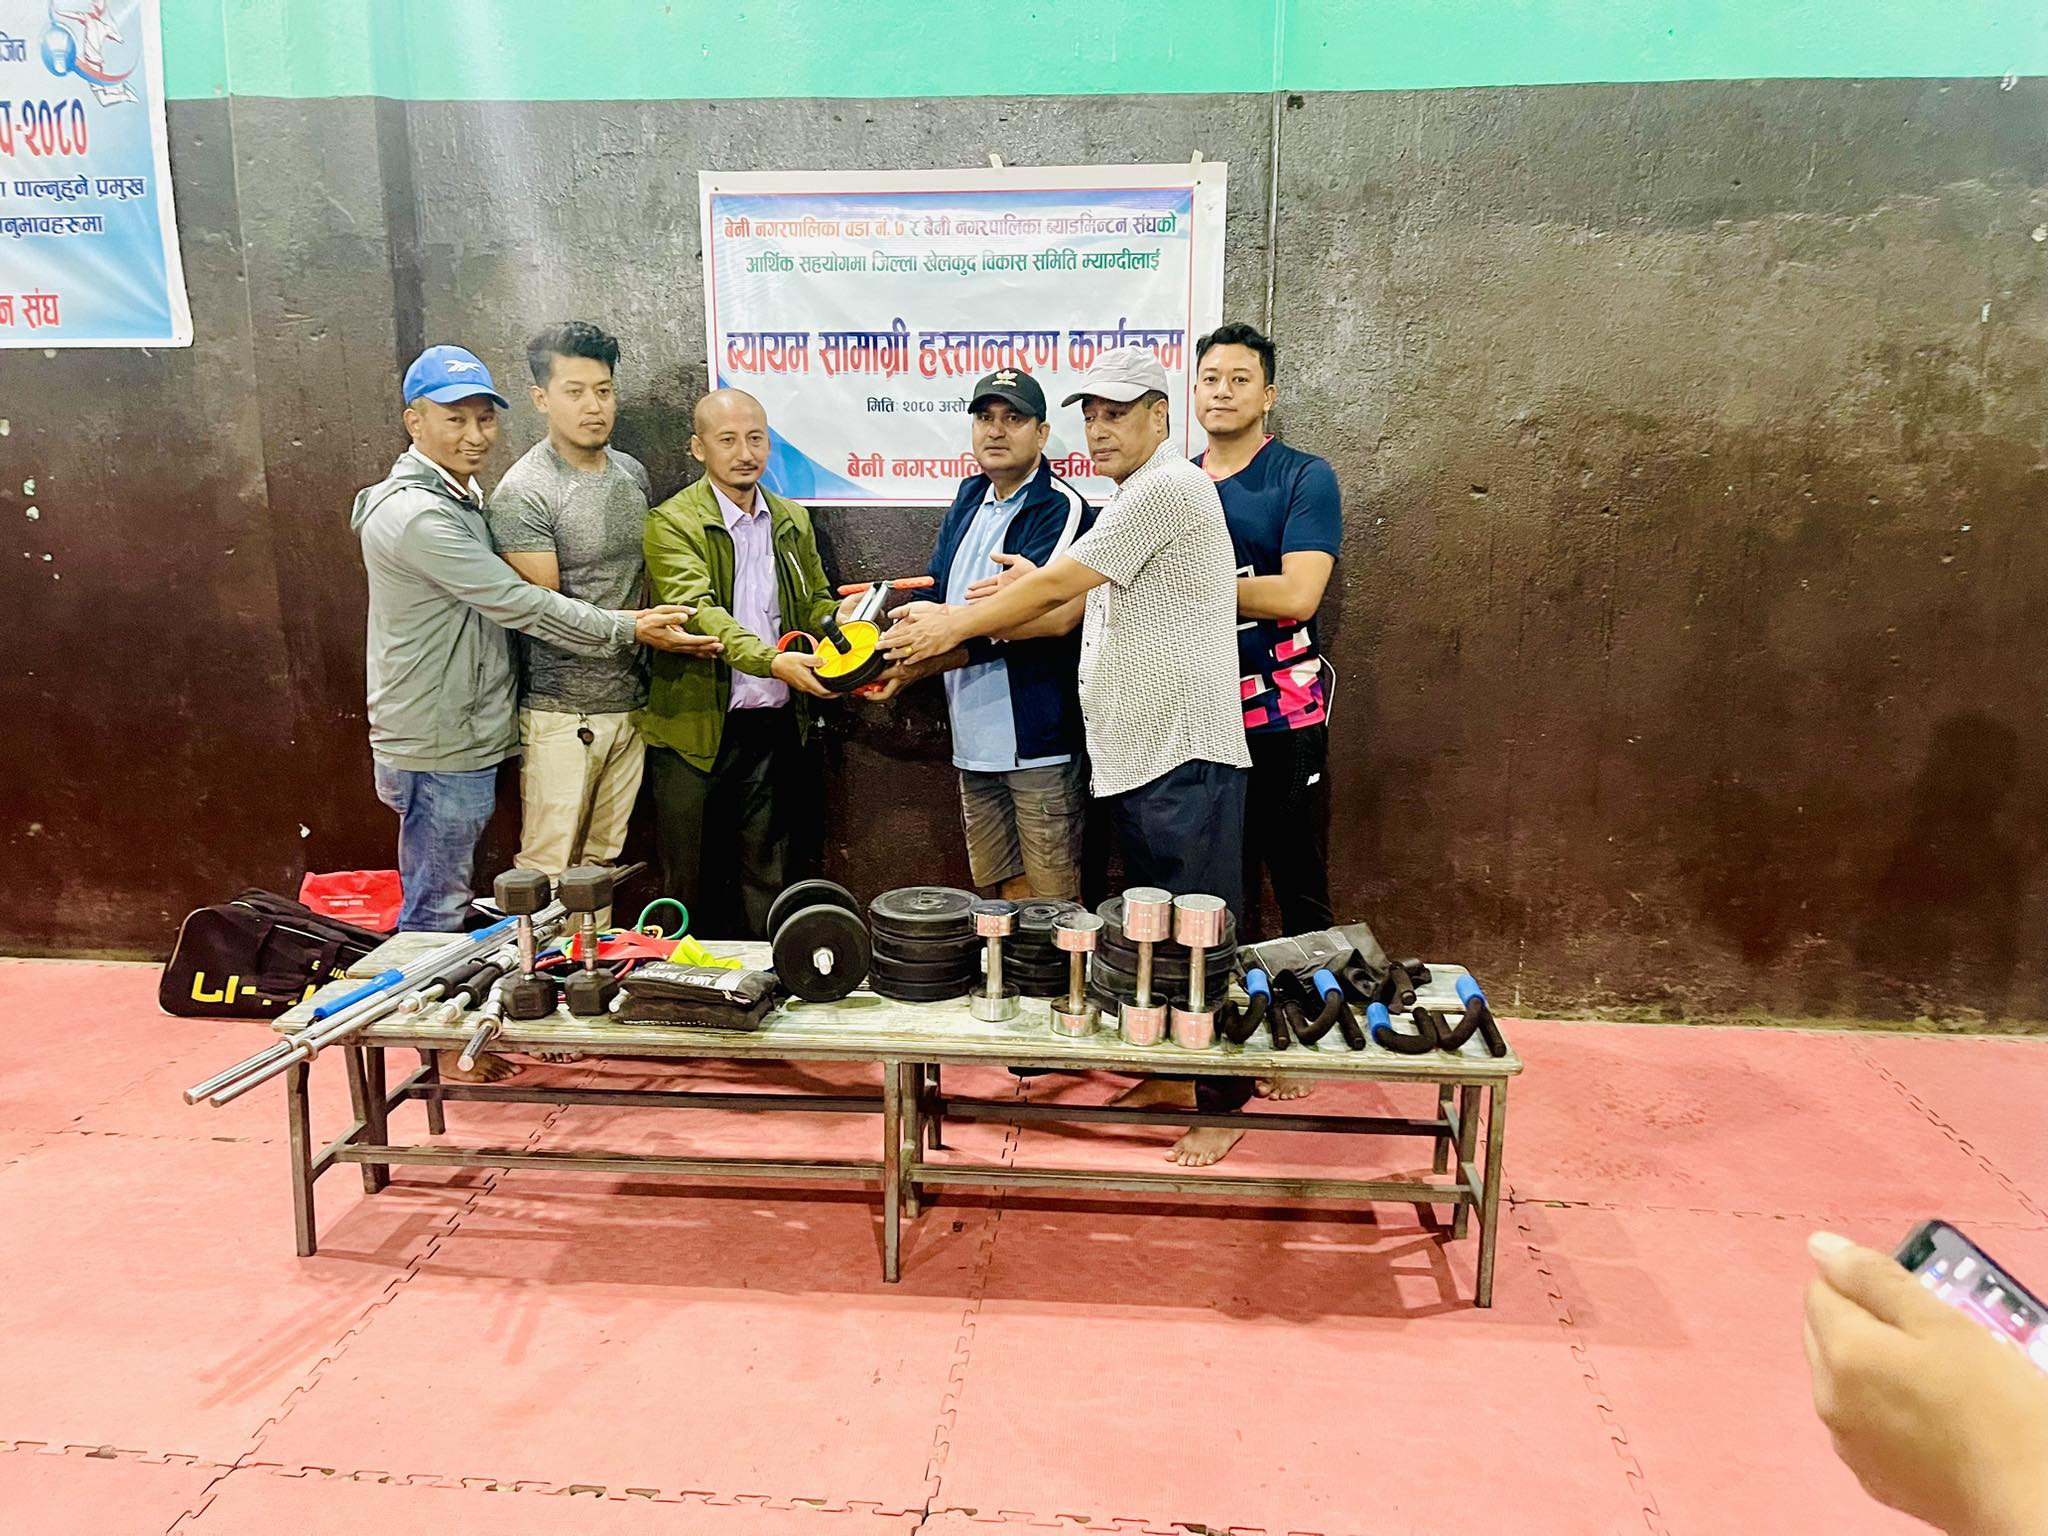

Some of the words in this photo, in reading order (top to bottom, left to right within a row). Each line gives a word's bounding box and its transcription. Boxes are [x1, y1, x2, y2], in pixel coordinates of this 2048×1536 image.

[96, 178, 144, 200] प्रमुख
[755, 216, 840, 238] नगरपालिका
[956, 213, 1041, 236] नगरपालिका
[1132, 210, 1177, 235] संघको
[745, 250, 794, 273] आर्थिक
[799, 250, 867, 274] सहयोगमा
[872, 250, 917, 272] जिल्ला
[923, 249, 976, 276] खेलकुद
[982, 248, 1027, 272] विकास
[1032, 247, 1077, 272] समिति
[1083, 247, 1161, 272] म्याग्दीलाई
[21, 288, 59, 329] संघ
[818, 316, 911, 379] सामाग्री
[918, 329, 1060, 379] हस्तान्तरण
[903, 400, 934, 413] २०८०
[847, 451, 885, 478] बेनी
[892, 451, 983, 479] नगरपालि
